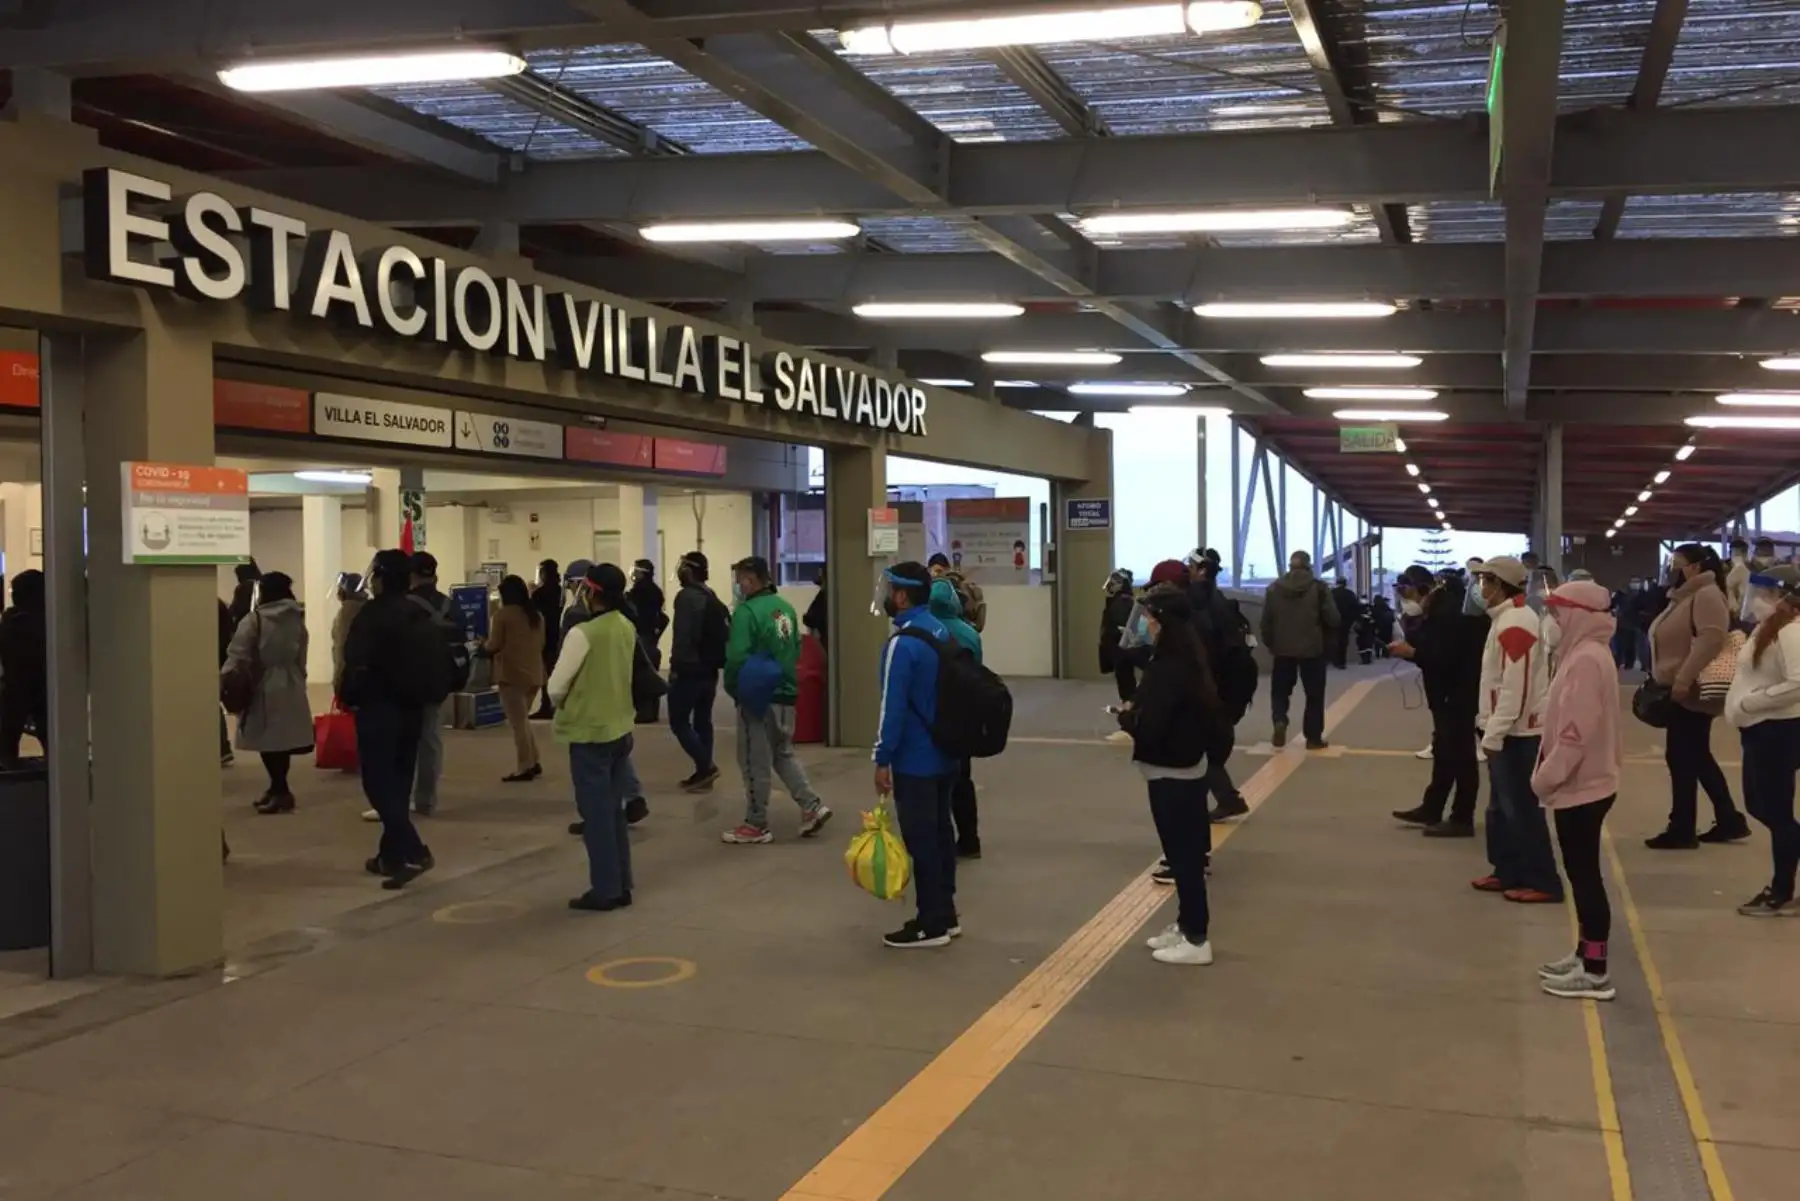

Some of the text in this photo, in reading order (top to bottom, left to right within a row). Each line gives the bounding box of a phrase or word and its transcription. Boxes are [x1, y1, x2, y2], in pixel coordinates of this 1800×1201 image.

[107, 168, 928, 436] ESTACION VILLA EL SALVADOR
[324, 405, 446, 434] VILLA EL SALVADOR
[1343, 431, 1396, 448] SALIDA
[135, 465, 170, 478] COVID
[178, 470, 191, 481] 19
